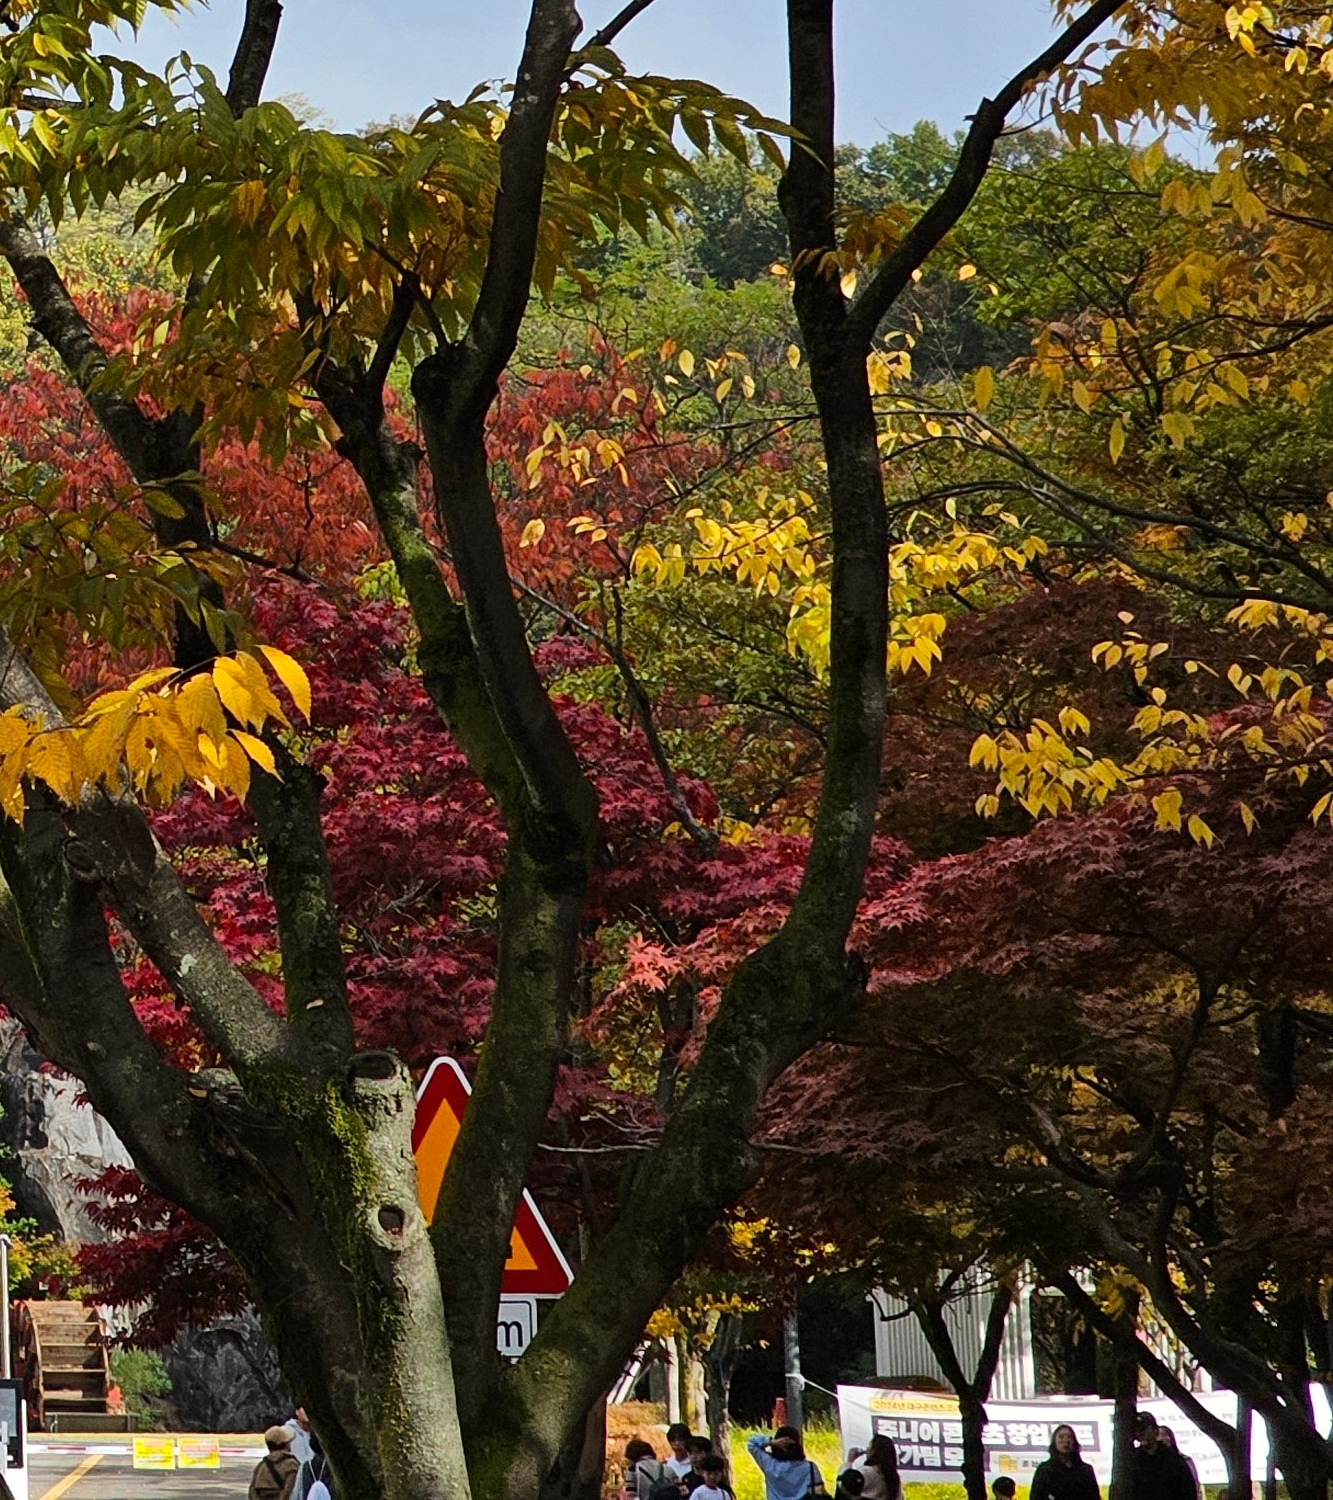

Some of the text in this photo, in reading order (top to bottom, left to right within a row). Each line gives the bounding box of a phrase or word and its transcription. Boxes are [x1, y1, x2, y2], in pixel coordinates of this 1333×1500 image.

[877, 1418, 940, 1444] 주니어
[942, 1422, 1006, 1445] 콘츠
[894, 1443, 942, 1467] 가팀
